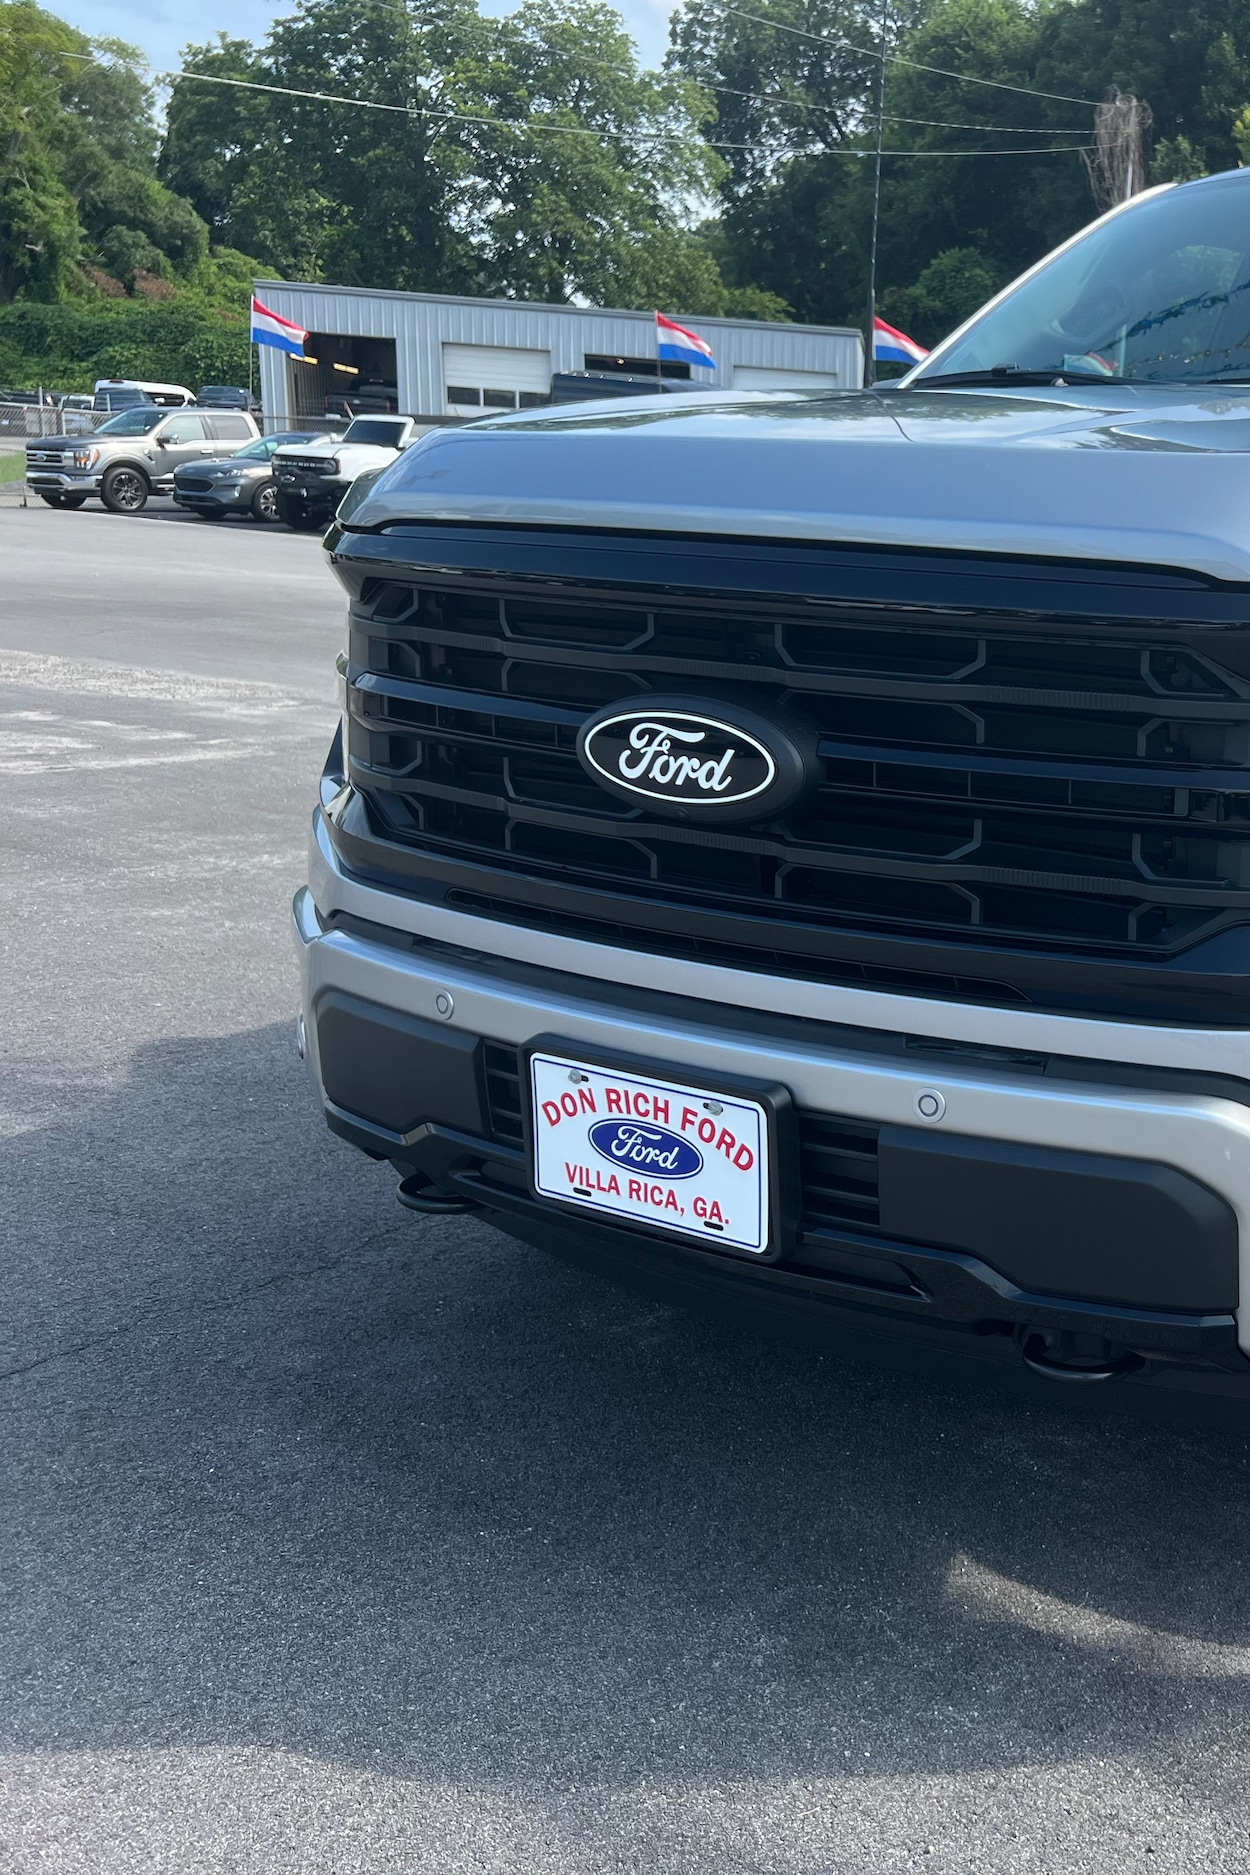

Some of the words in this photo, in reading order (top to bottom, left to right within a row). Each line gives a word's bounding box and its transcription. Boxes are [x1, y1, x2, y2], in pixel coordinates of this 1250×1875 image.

[618, 722, 735, 791] Ford
[541, 1087, 597, 1127] DON
[605, 1087, 669, 1124] RICH
[680, 1106, 754, 1171] FORD
[610, 1125, 679, 1170] Ford
[565, 1162, 621, 1196] VILLA
[628, 1178, 685, 1217] RICA,
[693, 1196, 730, 1224] GA.
